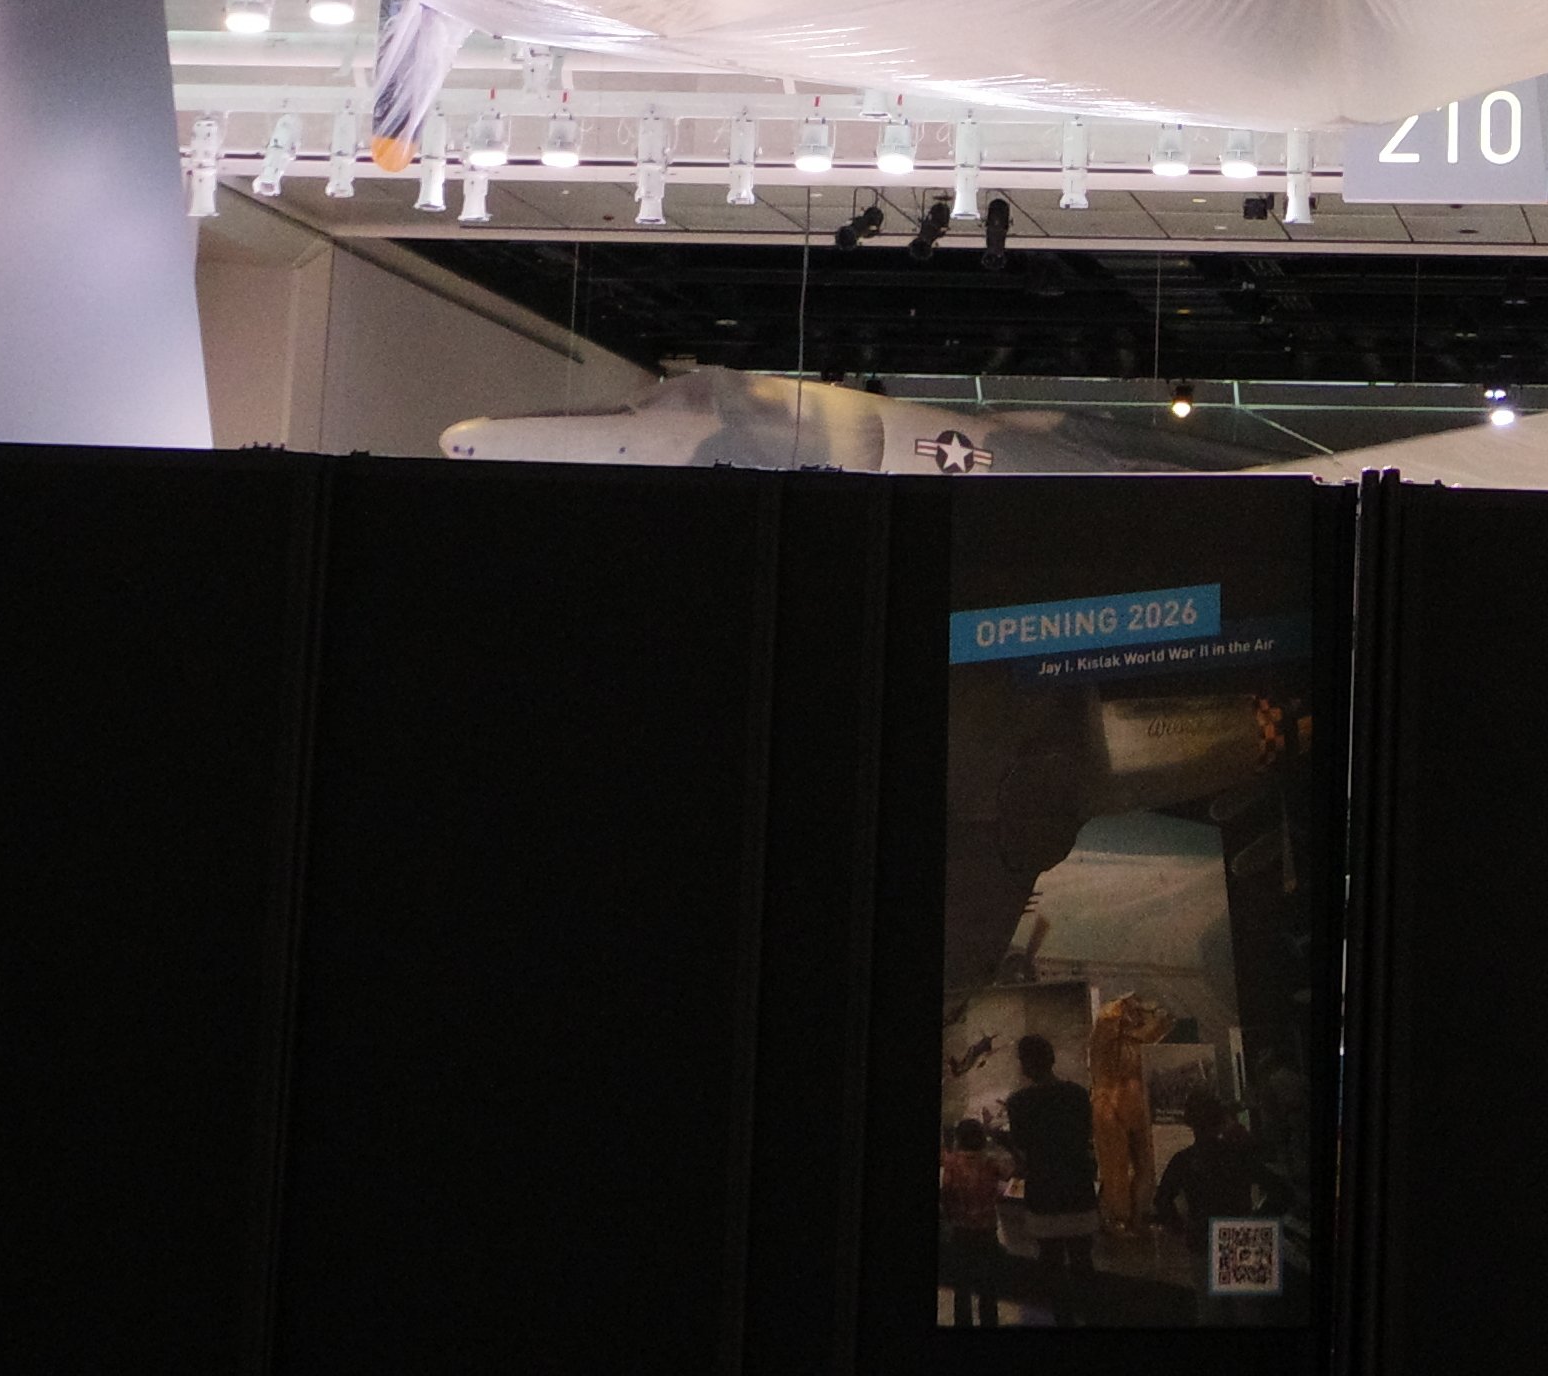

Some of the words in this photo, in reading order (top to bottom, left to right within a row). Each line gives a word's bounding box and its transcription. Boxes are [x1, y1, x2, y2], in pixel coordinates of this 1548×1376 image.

[976, 607, 1118, 646] OPENING
[1128, 599, 1197, 630] 2026
[1038, 661, 1062, 677] Jay
[1076, 653, 1121, 672] Kislak
[1123, 648, 1165, 667] World
[1167, 646, 1196, 661] War
[1211, 642, 1226, 657] in
[1228, 639, 1251, 655] the
[1253, 637, 1276, 652] Air
